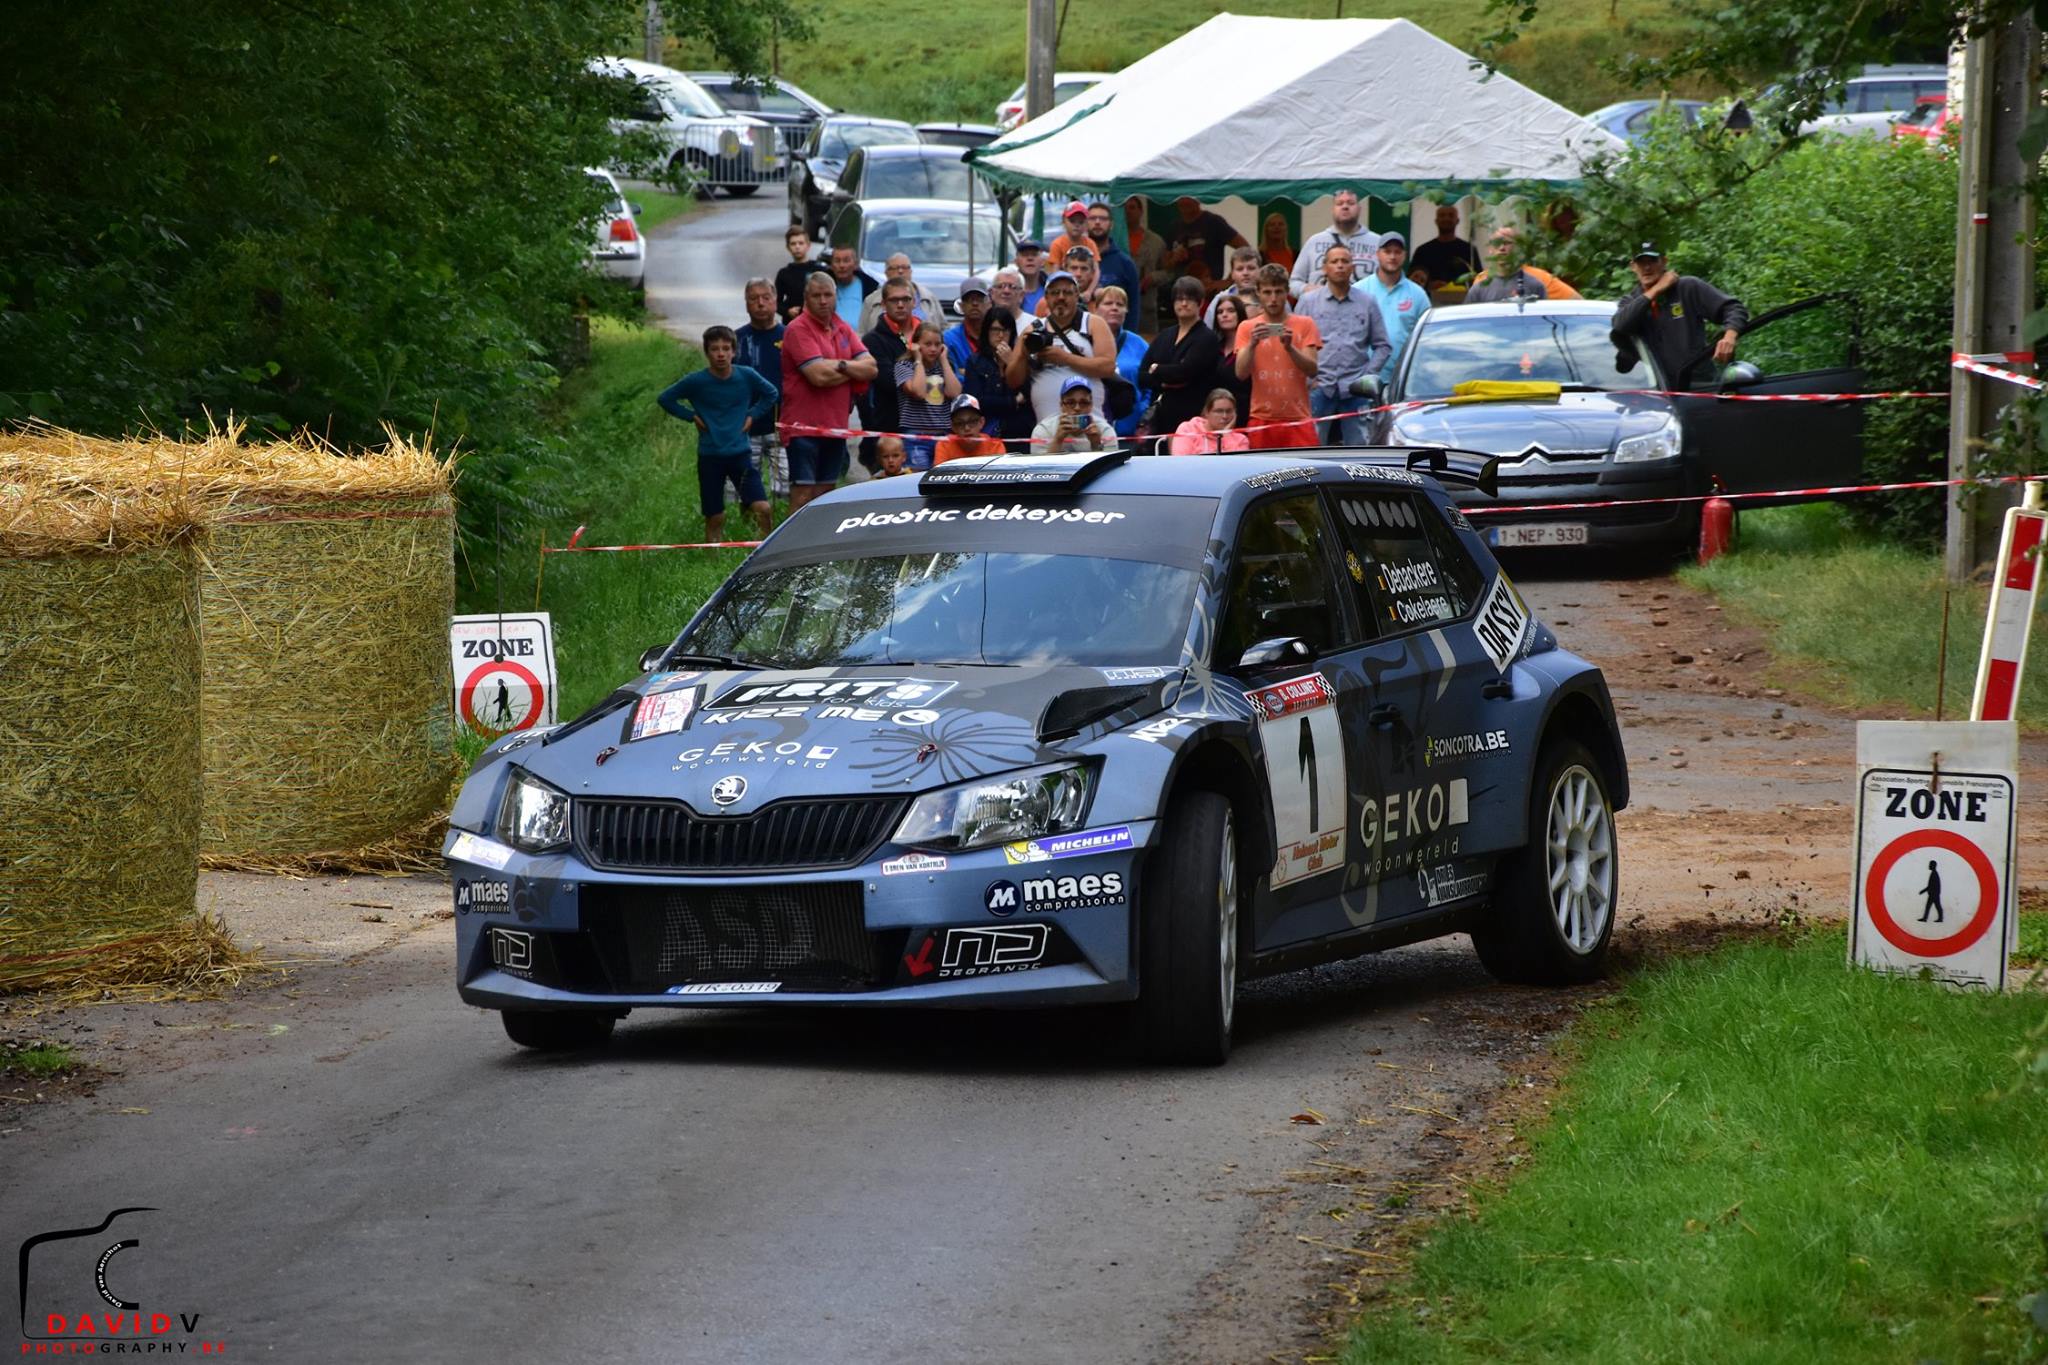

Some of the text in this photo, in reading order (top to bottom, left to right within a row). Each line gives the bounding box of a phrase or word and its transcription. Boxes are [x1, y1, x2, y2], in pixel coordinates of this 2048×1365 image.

[928, 472, 1060, 483] tangheprinting.com
[835, 504, 1126, 534] plastic dekeyser
[1381, 558, 1437, 594] Debackere
[1396, 595, 1450, 623] Cokelaere
[1478, 579, 1522, 665] DASSY
[462, 638, 534, 658] ZONE
[703, 706, 888, 724] KIZZ ME
[678, 742, 802, 763] GEKO
[1434, 730, 1509, 757] SONCOTRA.BE
[672, 755, 827, 772] woonwereld
[1297, 715, 1319, 834] 1
[1360, 783, 1444, 849] GEKO
[1885, 787, 1987, 822] ZONE
[1051, 830, 1129, 852] MICHELIN
[1364, 838, 1459, 876] woonwereld
[471, 881, 509, 903] maes
[1023, 872, 1123, 901] maes
[1025, 895, 1125, 912] compressoren
